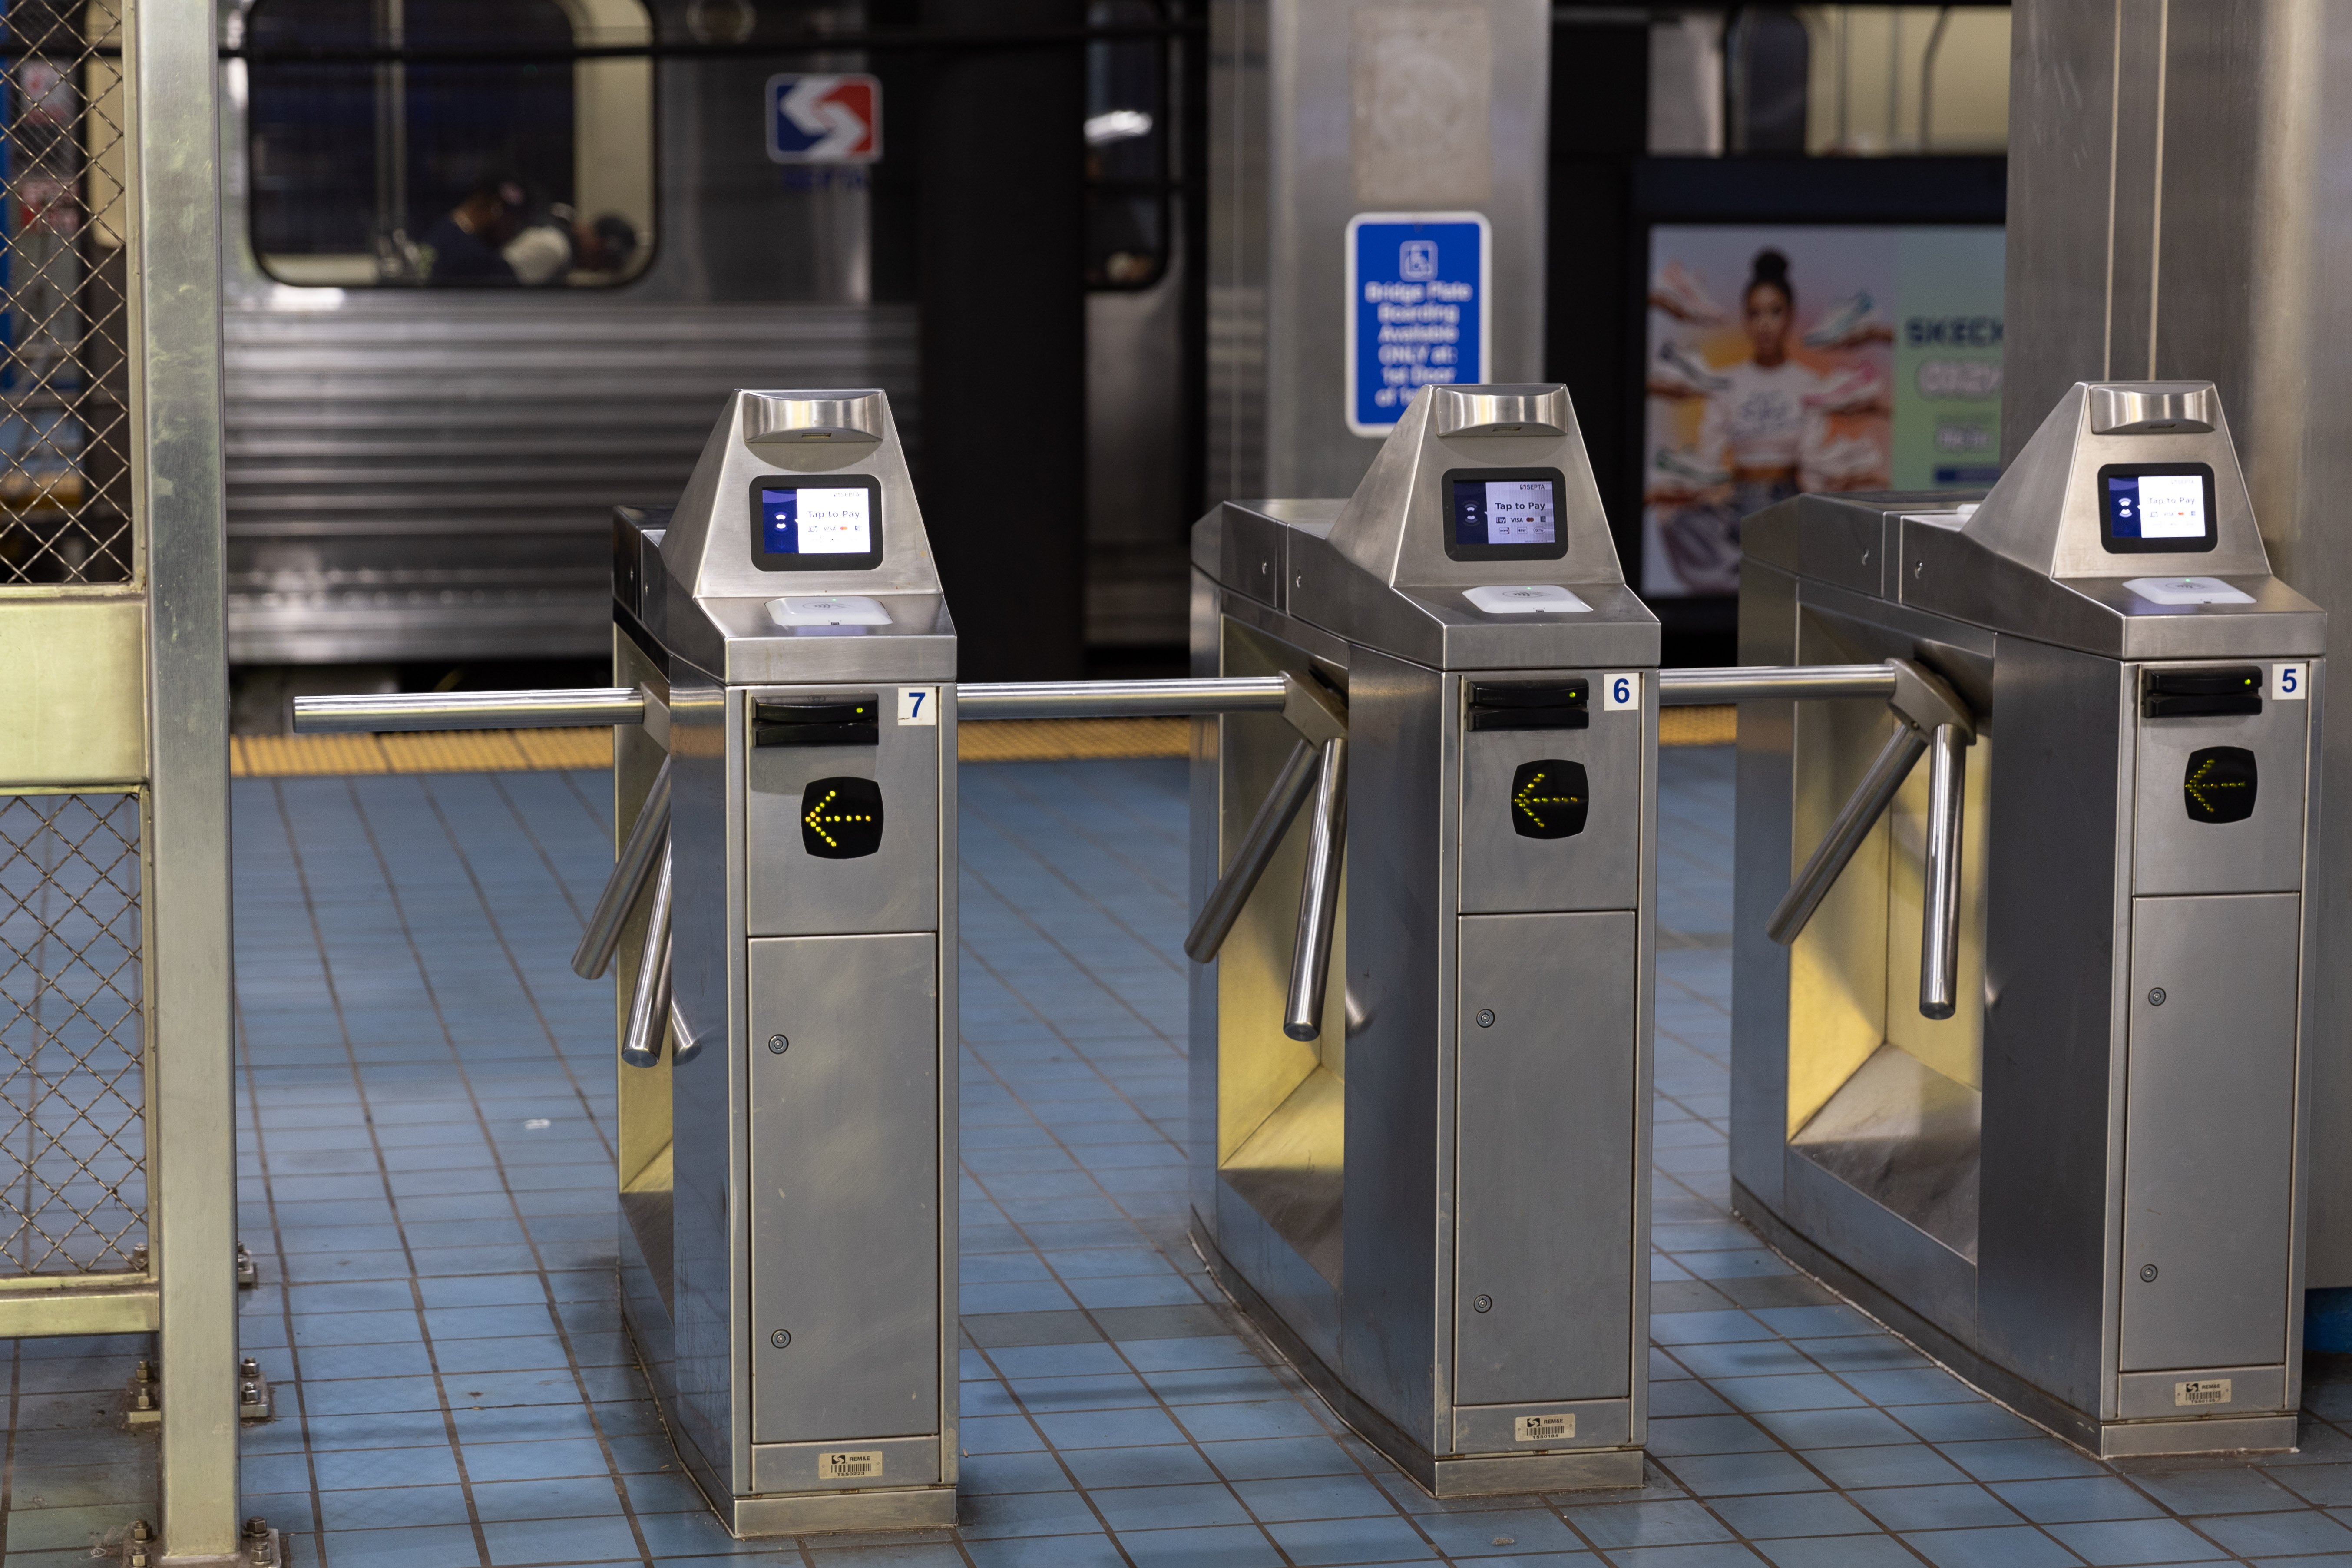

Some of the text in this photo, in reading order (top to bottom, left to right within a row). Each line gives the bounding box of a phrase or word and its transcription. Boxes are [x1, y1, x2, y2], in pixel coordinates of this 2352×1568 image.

[807, 511, 824, 519] Tap
[843, 511, 860, 519] Pay
[1495, 503, 1512, 511] Tap
[1528, 502, 1545, 511] Pay
[1613, 678, 1630, 703] 6
[2281, 669, 2297, 693] 5
[908, 692, 926, 718] 7
